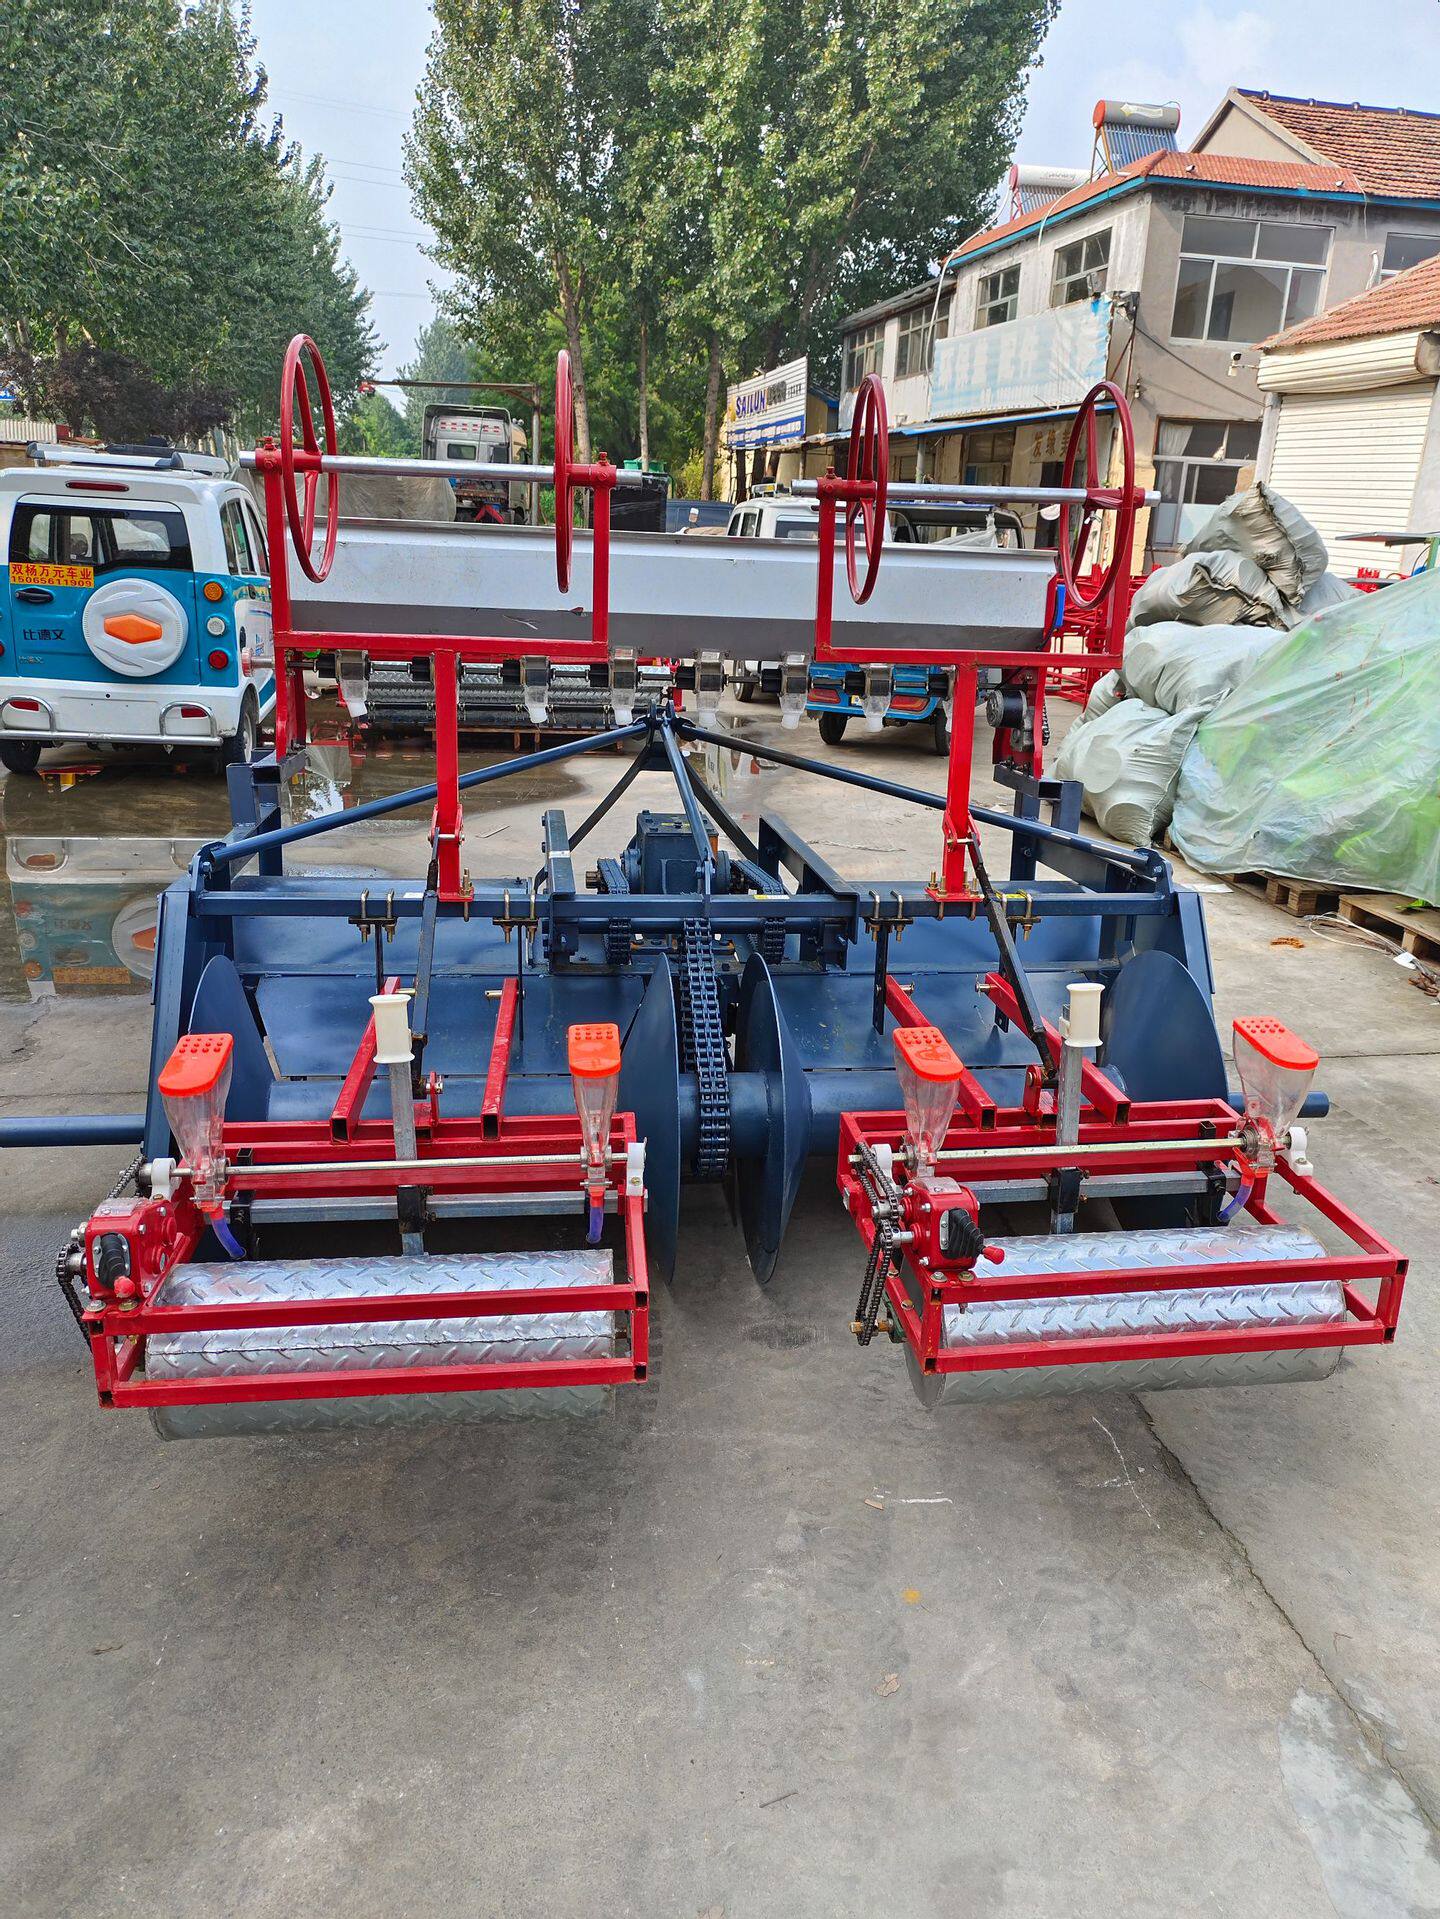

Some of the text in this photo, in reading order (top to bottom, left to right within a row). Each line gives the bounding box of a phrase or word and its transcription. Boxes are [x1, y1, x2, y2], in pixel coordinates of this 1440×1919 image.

[736, 389, 767, 419] SAILUN
[11, 563, 92, 580] 双杨万元车业
[11, 575, 92, 587] 15065611909
